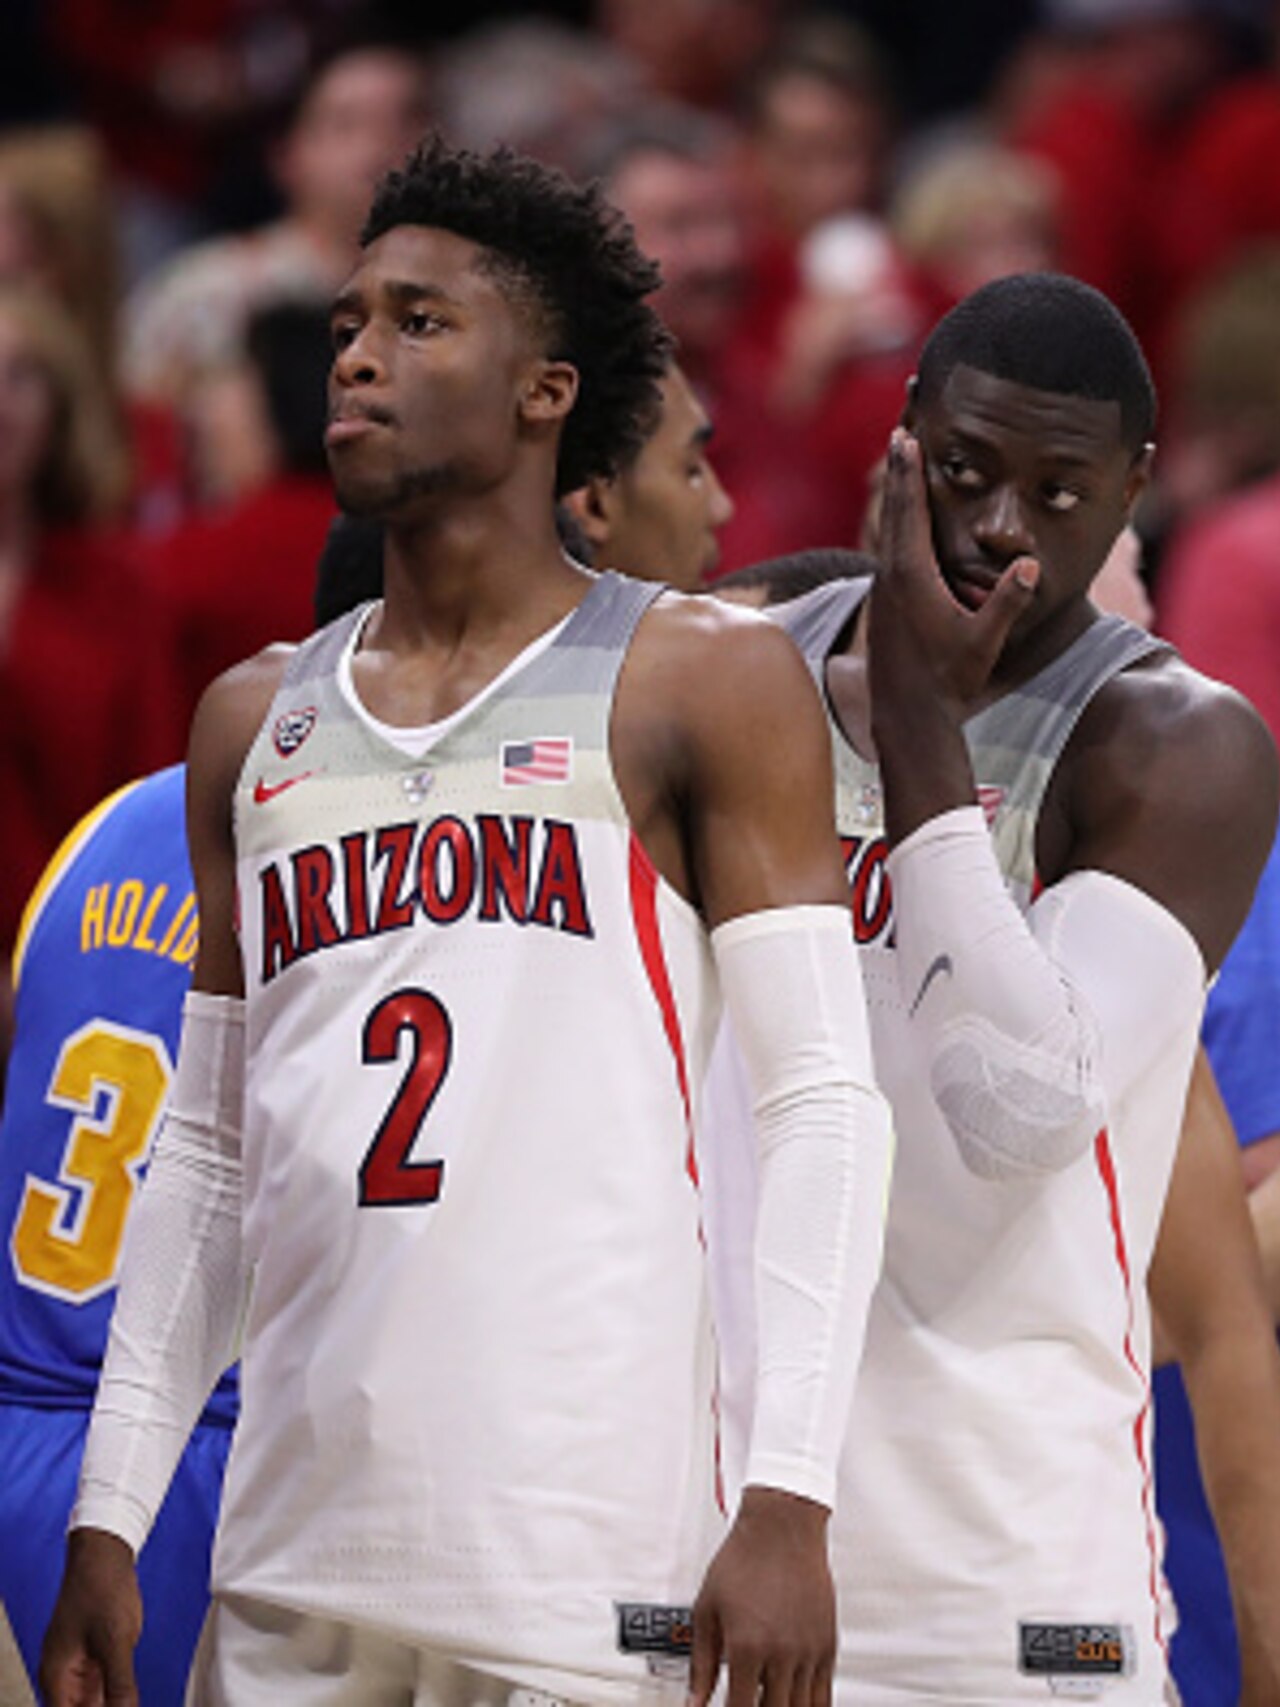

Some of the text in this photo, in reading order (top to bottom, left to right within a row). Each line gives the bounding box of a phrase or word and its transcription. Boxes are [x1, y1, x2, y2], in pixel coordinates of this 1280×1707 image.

[80, 877, 199, 972] HOLID
[260, 813, 595, 985] ARIZONA
[10, 1017, 177, 1305] 3
[357, 986, 454, 1208] 2
